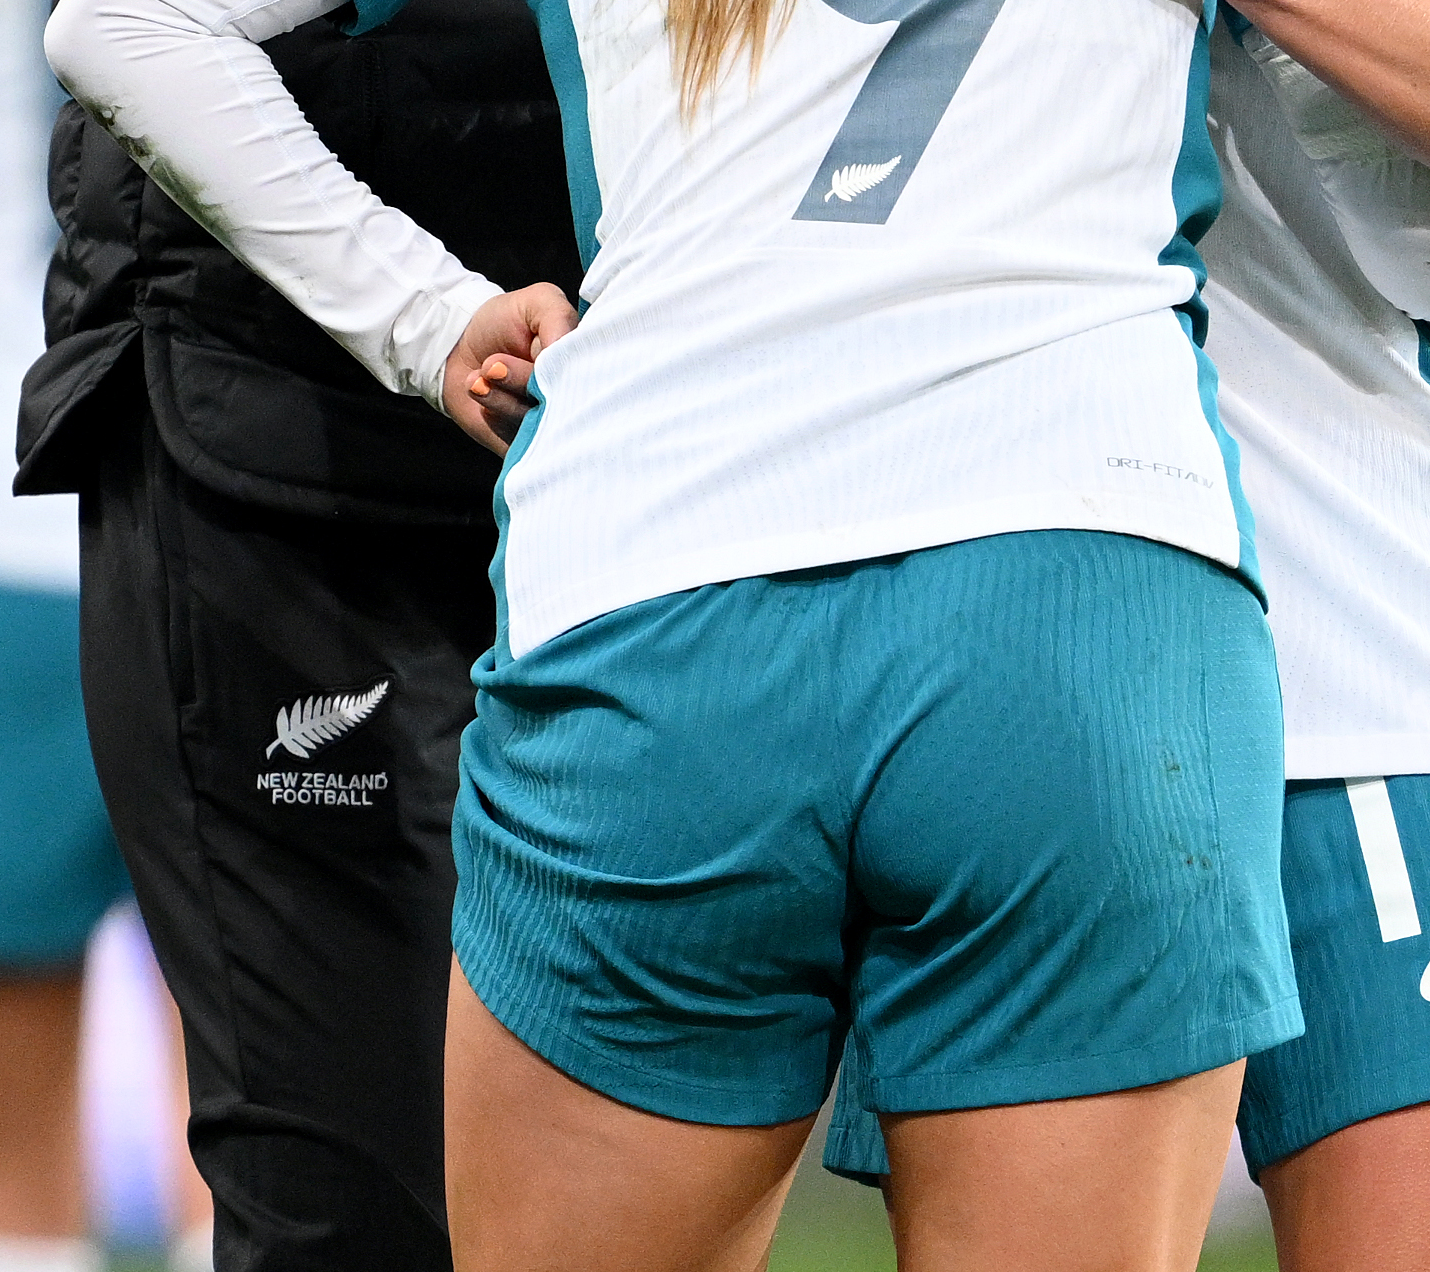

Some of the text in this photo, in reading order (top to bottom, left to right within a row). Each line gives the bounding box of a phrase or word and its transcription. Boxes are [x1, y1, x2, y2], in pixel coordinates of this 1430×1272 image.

[256, 771, 389, 790] NEW ZEALAND
[272, 788, 374, 806] FOOTBALL
